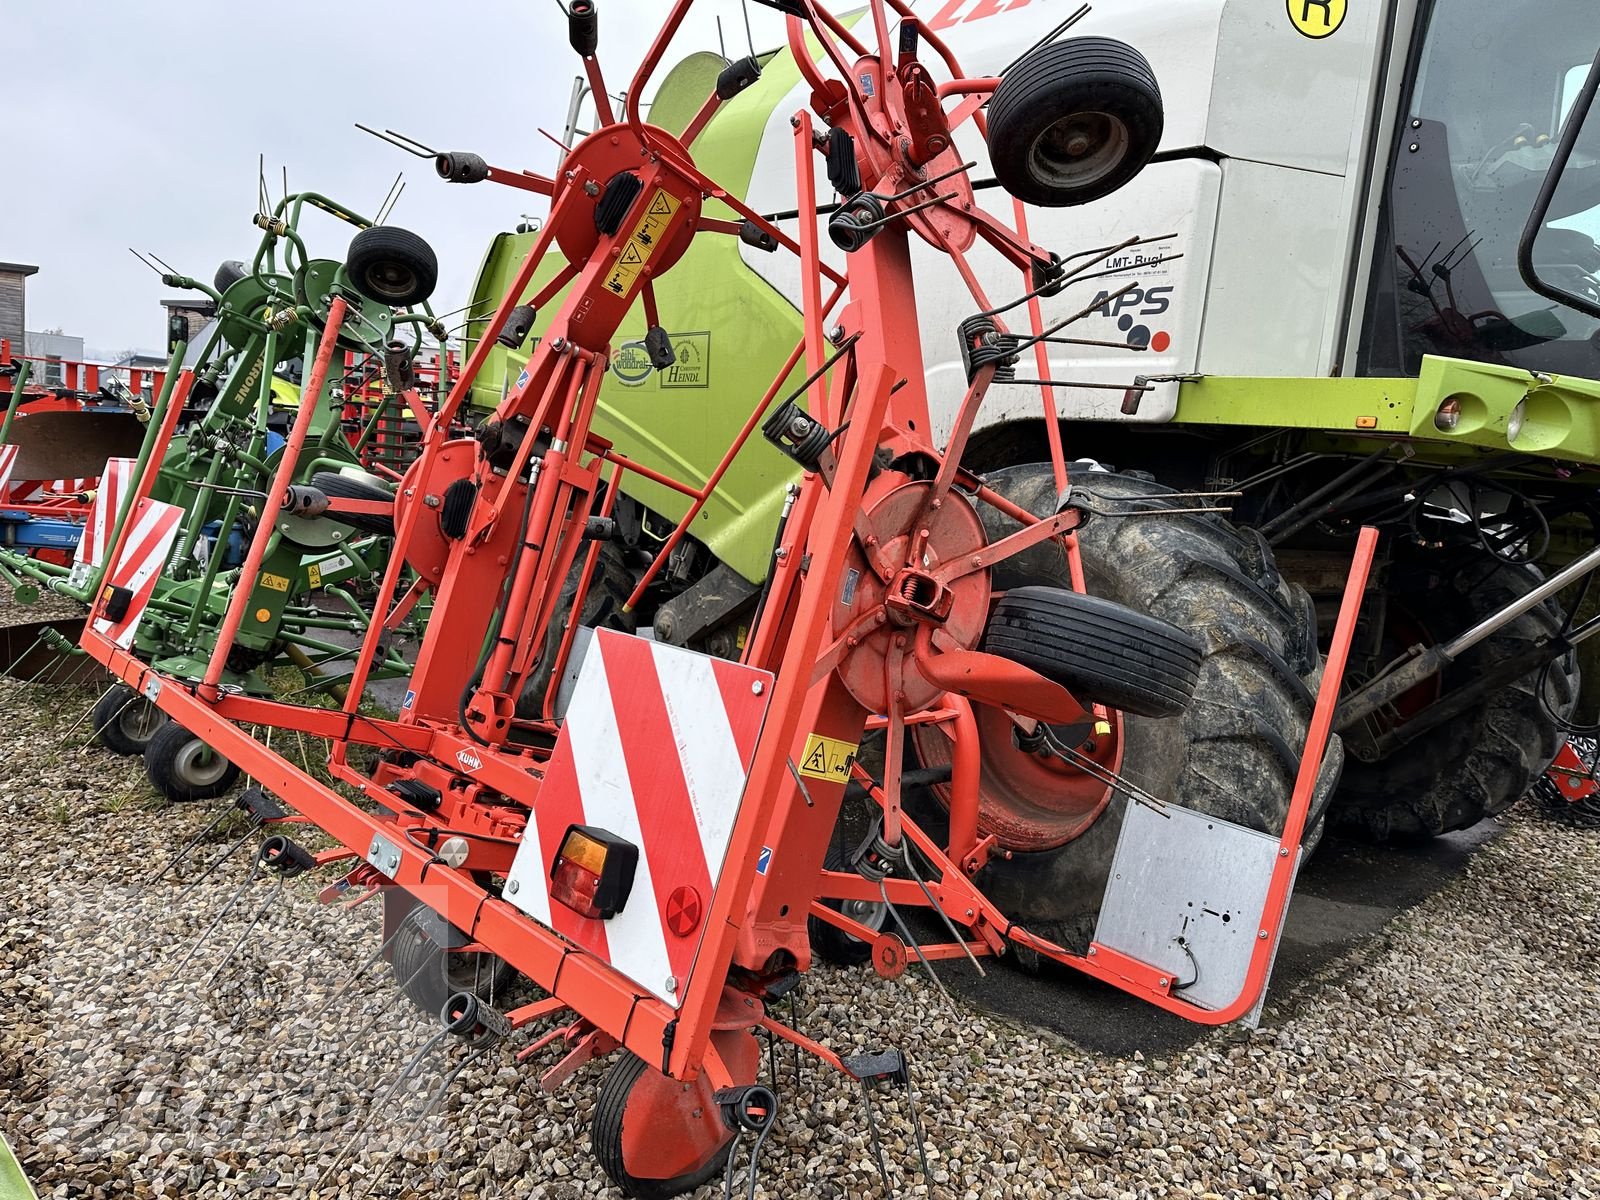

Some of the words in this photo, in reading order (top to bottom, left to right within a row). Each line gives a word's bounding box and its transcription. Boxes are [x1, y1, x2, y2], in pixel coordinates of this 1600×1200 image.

[1080, 285, 1174, 319] APS
[234, 358, 264, 405] KRONE
[460, 751, 480, 769] KUHN
